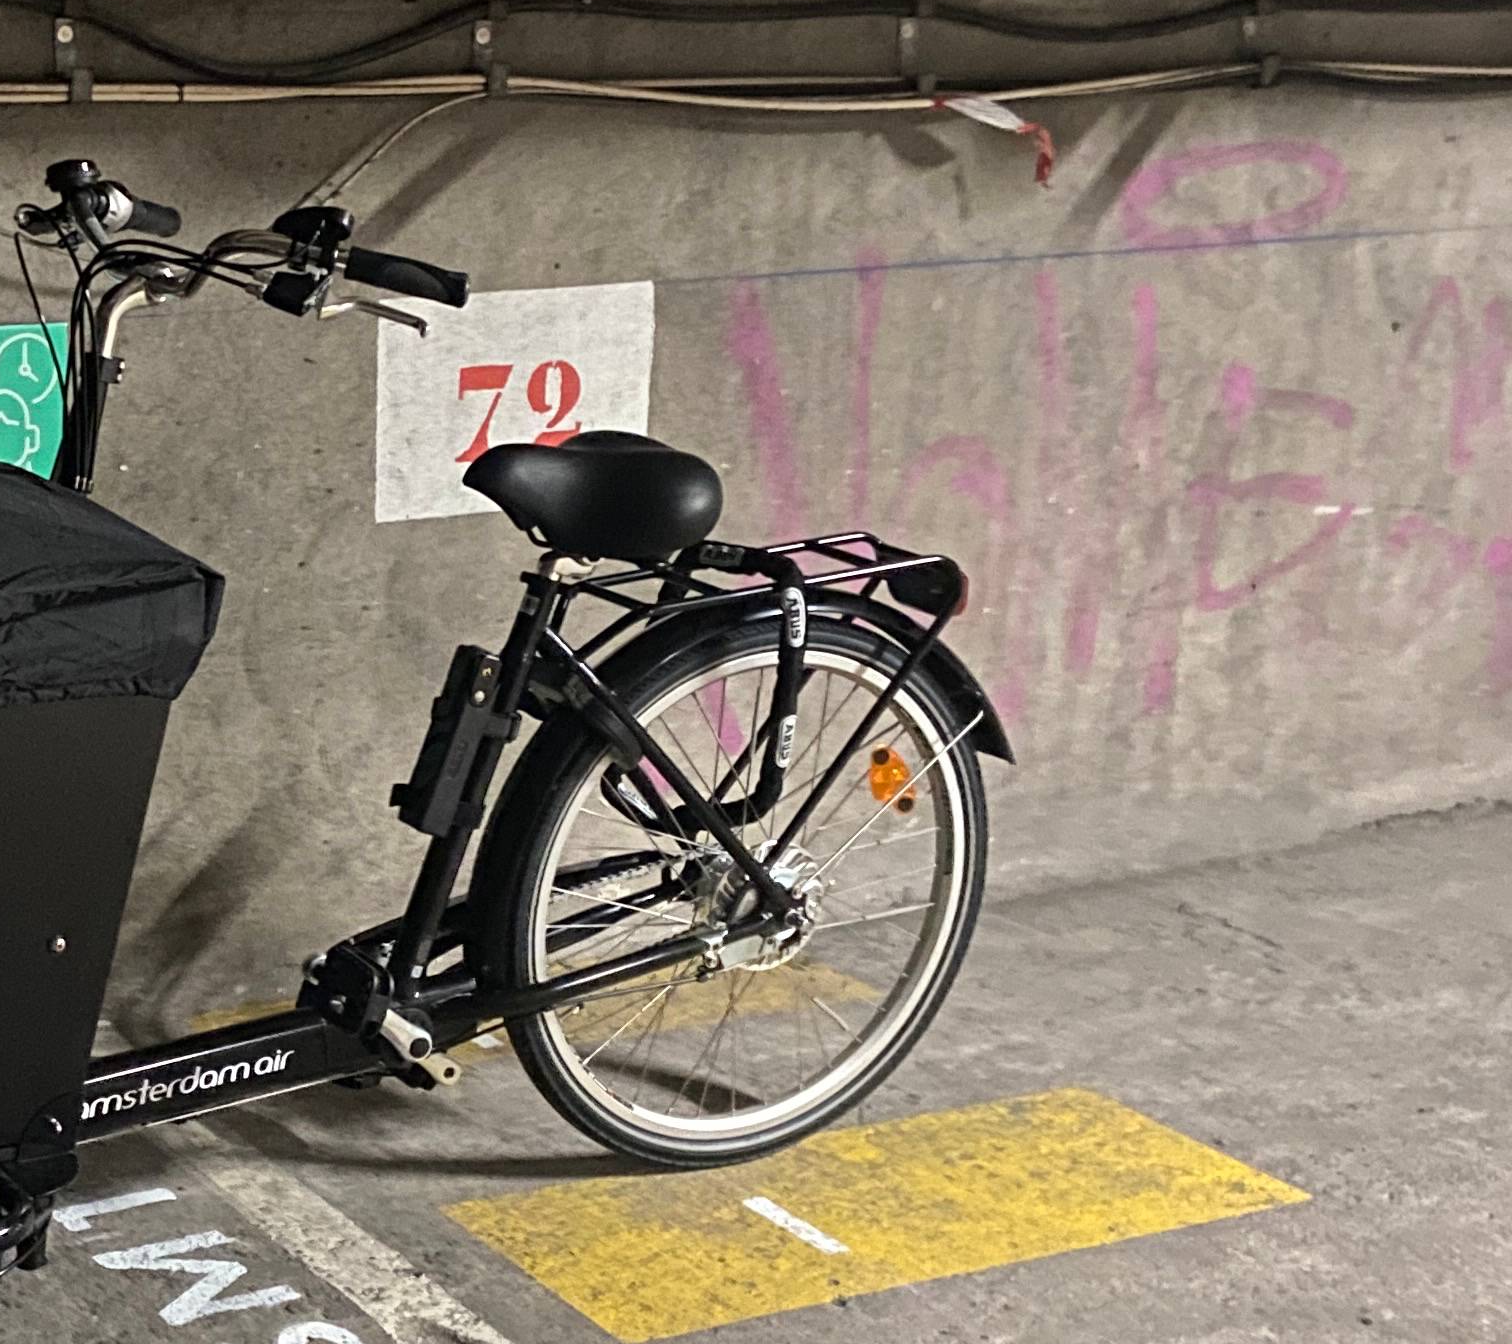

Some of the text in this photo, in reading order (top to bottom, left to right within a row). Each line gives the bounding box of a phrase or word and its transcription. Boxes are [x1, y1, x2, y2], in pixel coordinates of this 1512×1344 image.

[455, 359, 582, 463] 72
[786, 597, 803, 639] ABUS
[254, 1049, 295, 1076] air
